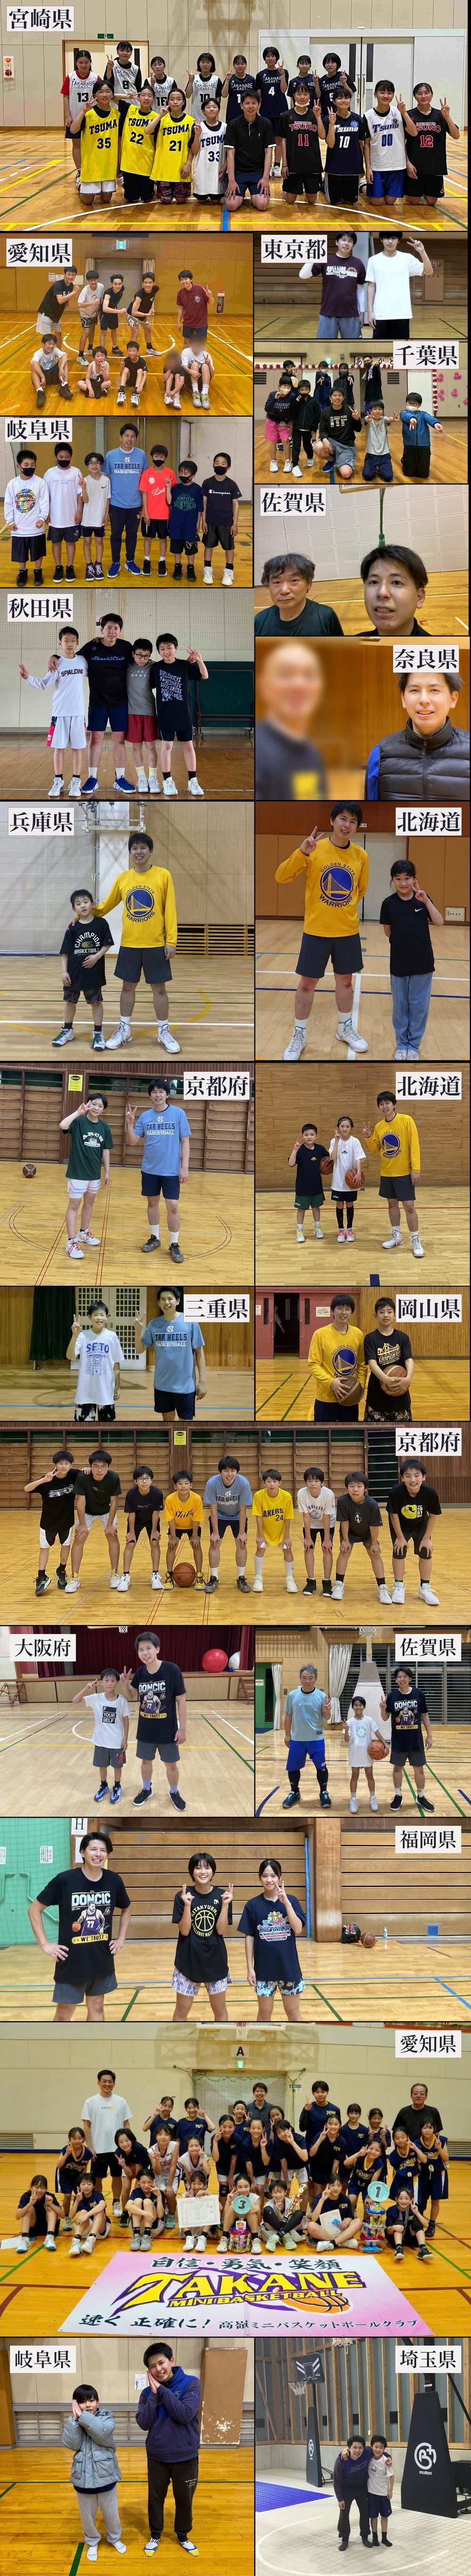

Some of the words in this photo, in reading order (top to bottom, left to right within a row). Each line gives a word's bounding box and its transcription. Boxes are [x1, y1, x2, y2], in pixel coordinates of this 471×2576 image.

[122, 81, 129, 89] 8
[77, 92, 89, 102] 13
[268, 87, 275, 96] 4
[156, 97, 168, 107] 16
[89, 119, 117, 134] TSUMA
[129, 118, 153, 127] TSUM
[289, 124, 317, 132] TSUNO
[333, 124, 358, 132] Tsuno
[372, 123, 399, 134] Tsuno
[163, 124, 189, 136] TSUMA
[416, 125, 441, 133] SUNO
[97, 137, 111, 149] 35
[130, 132, 144, 145] 22
[298, 134, 309, 146] 11
[339, 136, 350, 149] 10
[382, 133, 393, 147] 00
[420, 135, 433, 148] 12
[169, 140, 182, 152] 21
[208, 151, 220, 162] 33
[61, 669, 83, 677] SPALDING
[160, 669, 181, 683] WILDNESS
[320, 862, 341, 872] GOLDEN
[343, 864, 356, 876] STATE
[125, 885, 141, 896] GOLDEN
[143, 885, 155, 894] STATE
[319, 894, 352, 908] WARRIORS
[126, 911, 155, 923] WARRIORS
[75, 932, 100, 948] CHAMPION
[82, 1132, 104, 1142] ARCH
[86, 1343, 109, 1353] SETO
[332, 1345, 345, 1355] GOLDEN
[379, 1354, 396, 1363] KANMON
[263, 1508, 284, 1518] AKERS
[75, 1818, 84, 1830] H
[236, 2047, 244, 2056] A
[375, 2186, 381, 2198] 1
[238, 2200, 246, 2209] 3
[151, 2257, 342, 2270] 自信・勇気・笑顔
[112, 2270, 366, 2315] TAKANE
[167, 2297, 213, 2307] MINI
[216, 2288, 342, 2304] BASKETBALL
[78, 2314, 121, 2327] 速く
